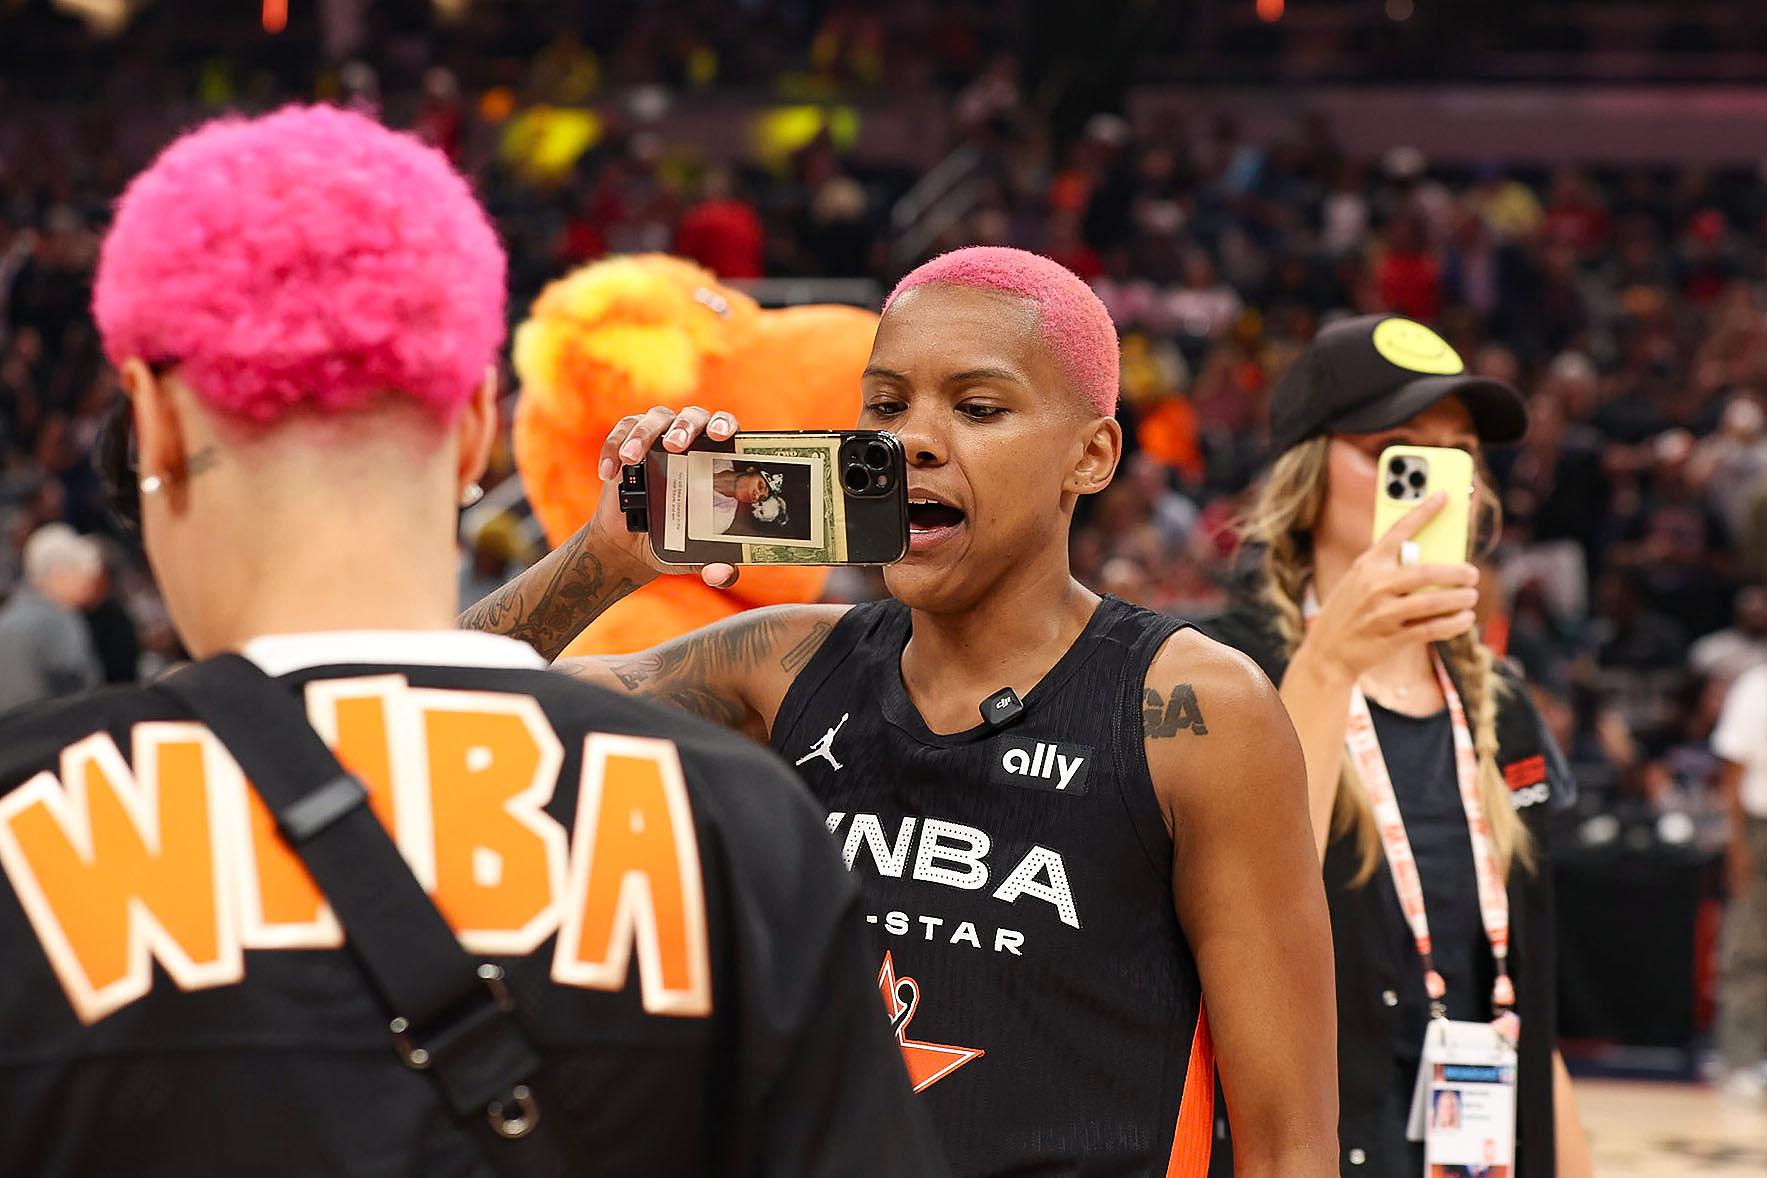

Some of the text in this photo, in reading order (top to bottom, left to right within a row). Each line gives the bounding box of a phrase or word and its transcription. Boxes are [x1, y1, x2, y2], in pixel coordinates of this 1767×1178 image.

[1002, 742, 1085, 790] ally
[824, 811, 1081, 930] NBA
[866, 911, 1026, 957] -STAR
